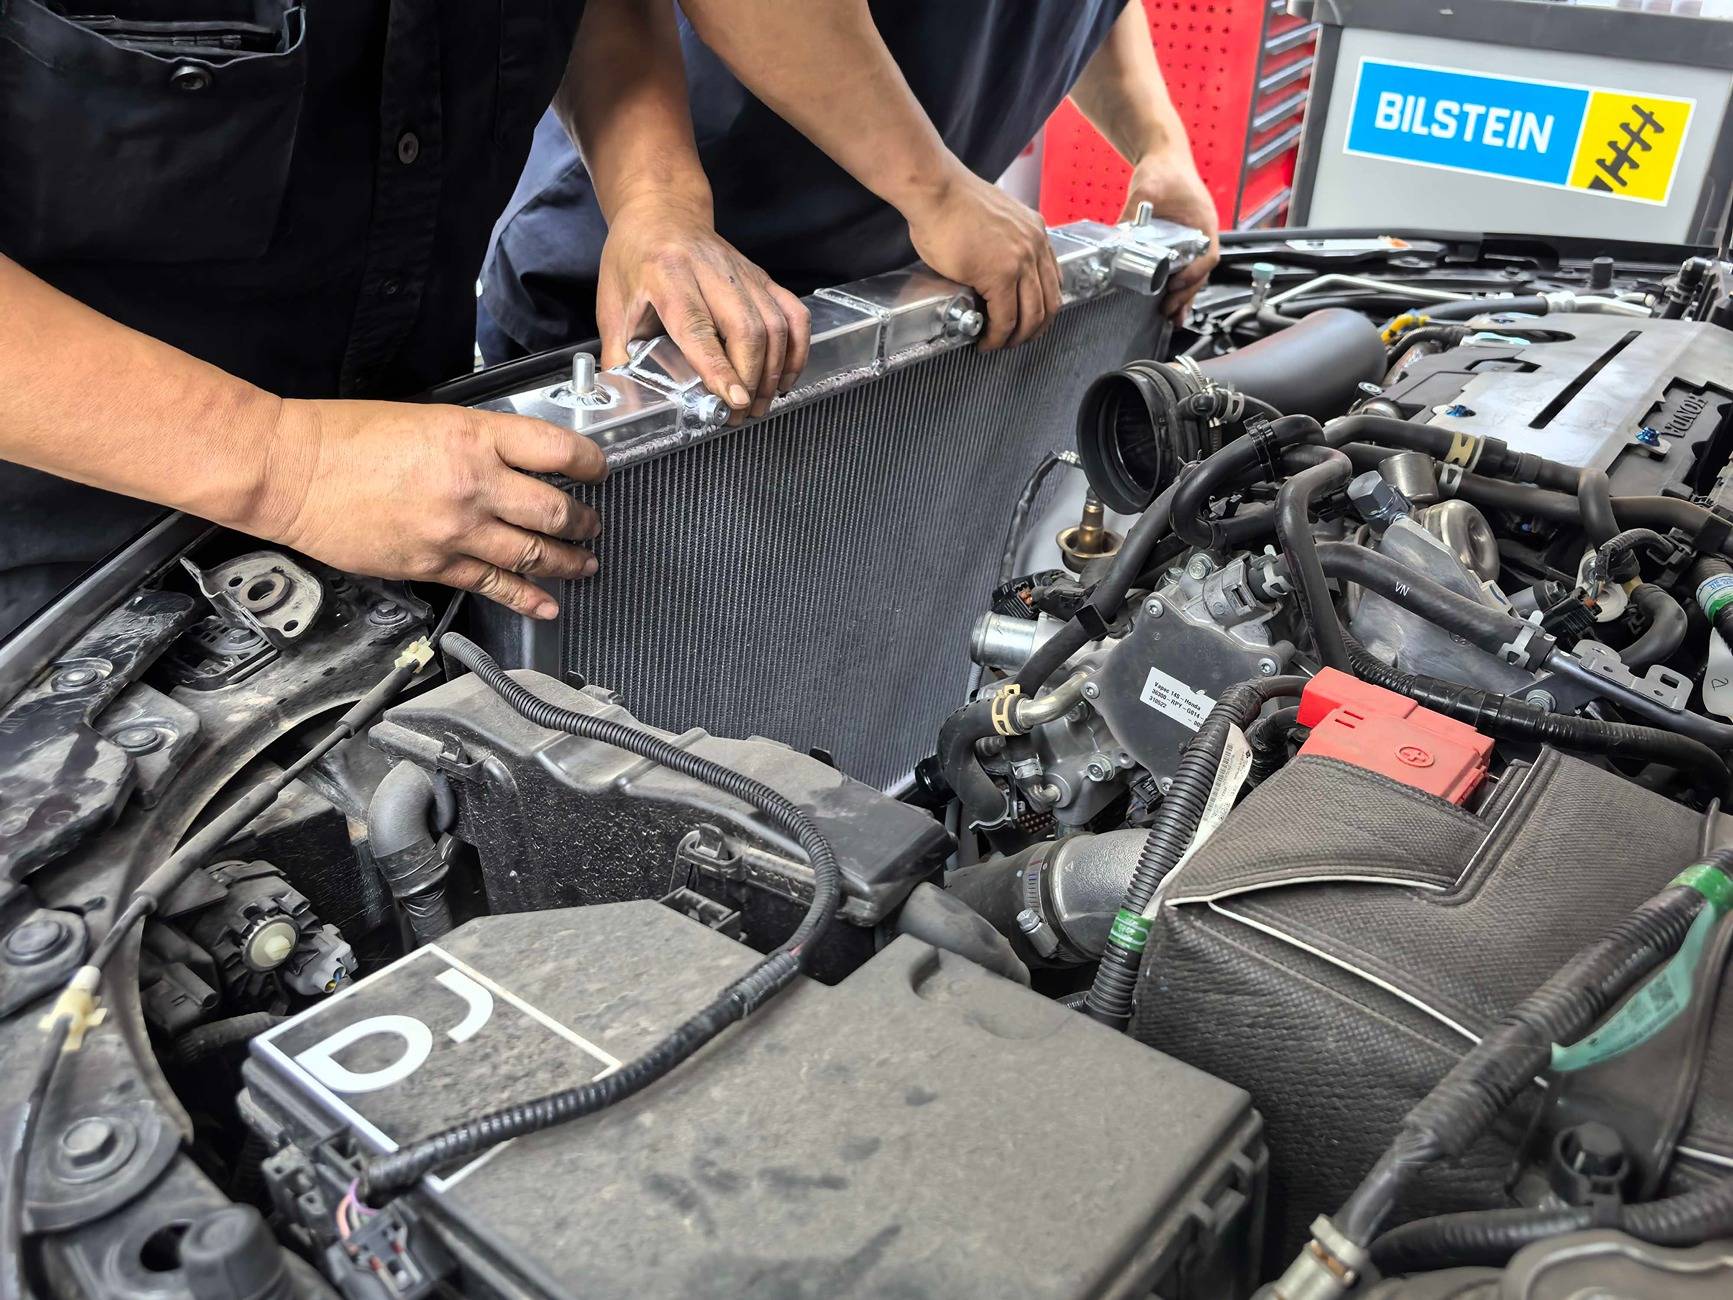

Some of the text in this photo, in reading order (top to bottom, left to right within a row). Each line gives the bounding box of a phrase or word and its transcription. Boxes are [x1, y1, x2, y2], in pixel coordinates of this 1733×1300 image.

[1374, 91, 1555, 154] BILSTEIN
[1661, 393, 1708, 438] HONDA
[1395, 581, 1410, 597] VN
